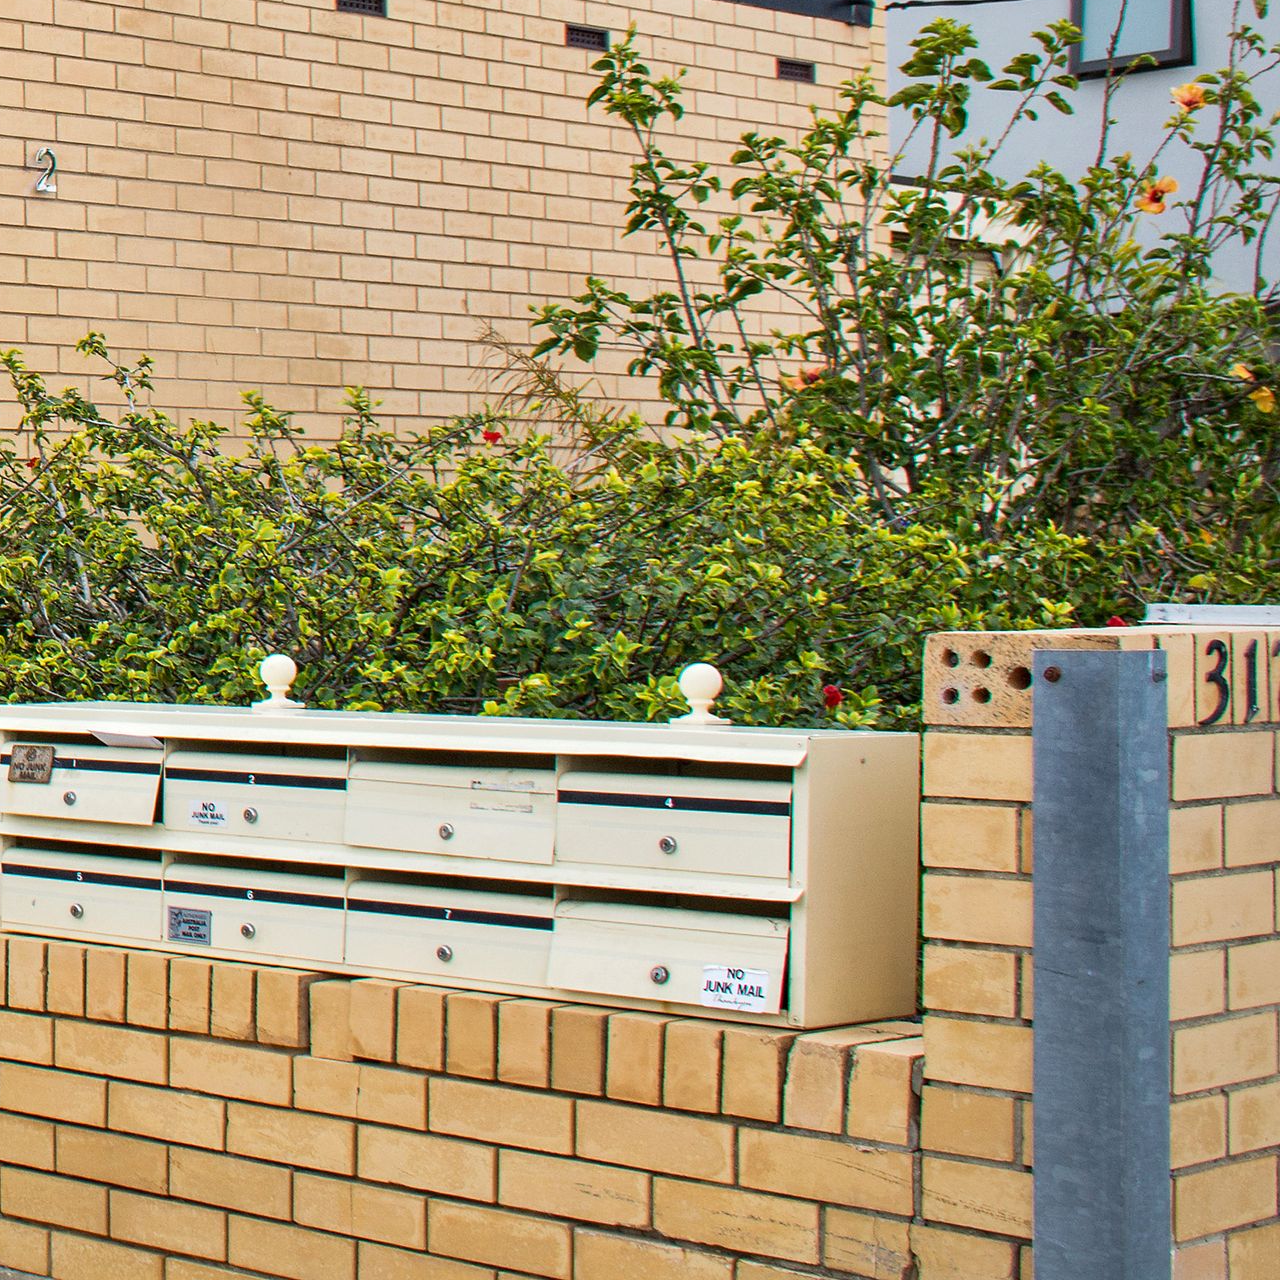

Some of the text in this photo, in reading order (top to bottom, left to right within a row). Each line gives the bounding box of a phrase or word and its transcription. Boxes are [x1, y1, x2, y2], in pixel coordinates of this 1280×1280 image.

[35, 147, 57, 192] 2
[1198, 638, 1280, 725] 31
[13, 762, 47, 772] NO JUNK
[247, 774, 256, 784] 2
[201, 802, 216, 812] NO
[664, 797, 674, 808] 4
[191, 811, 225, 821] JUNK MAIL
[76, 871, 83, 881] 5
[246, 889, 255, 900] 6
[443, 908, 452, 919] 7
[726, 968, 745, 980] NO
[703, 979, 765, 998] JUNK MAIL
